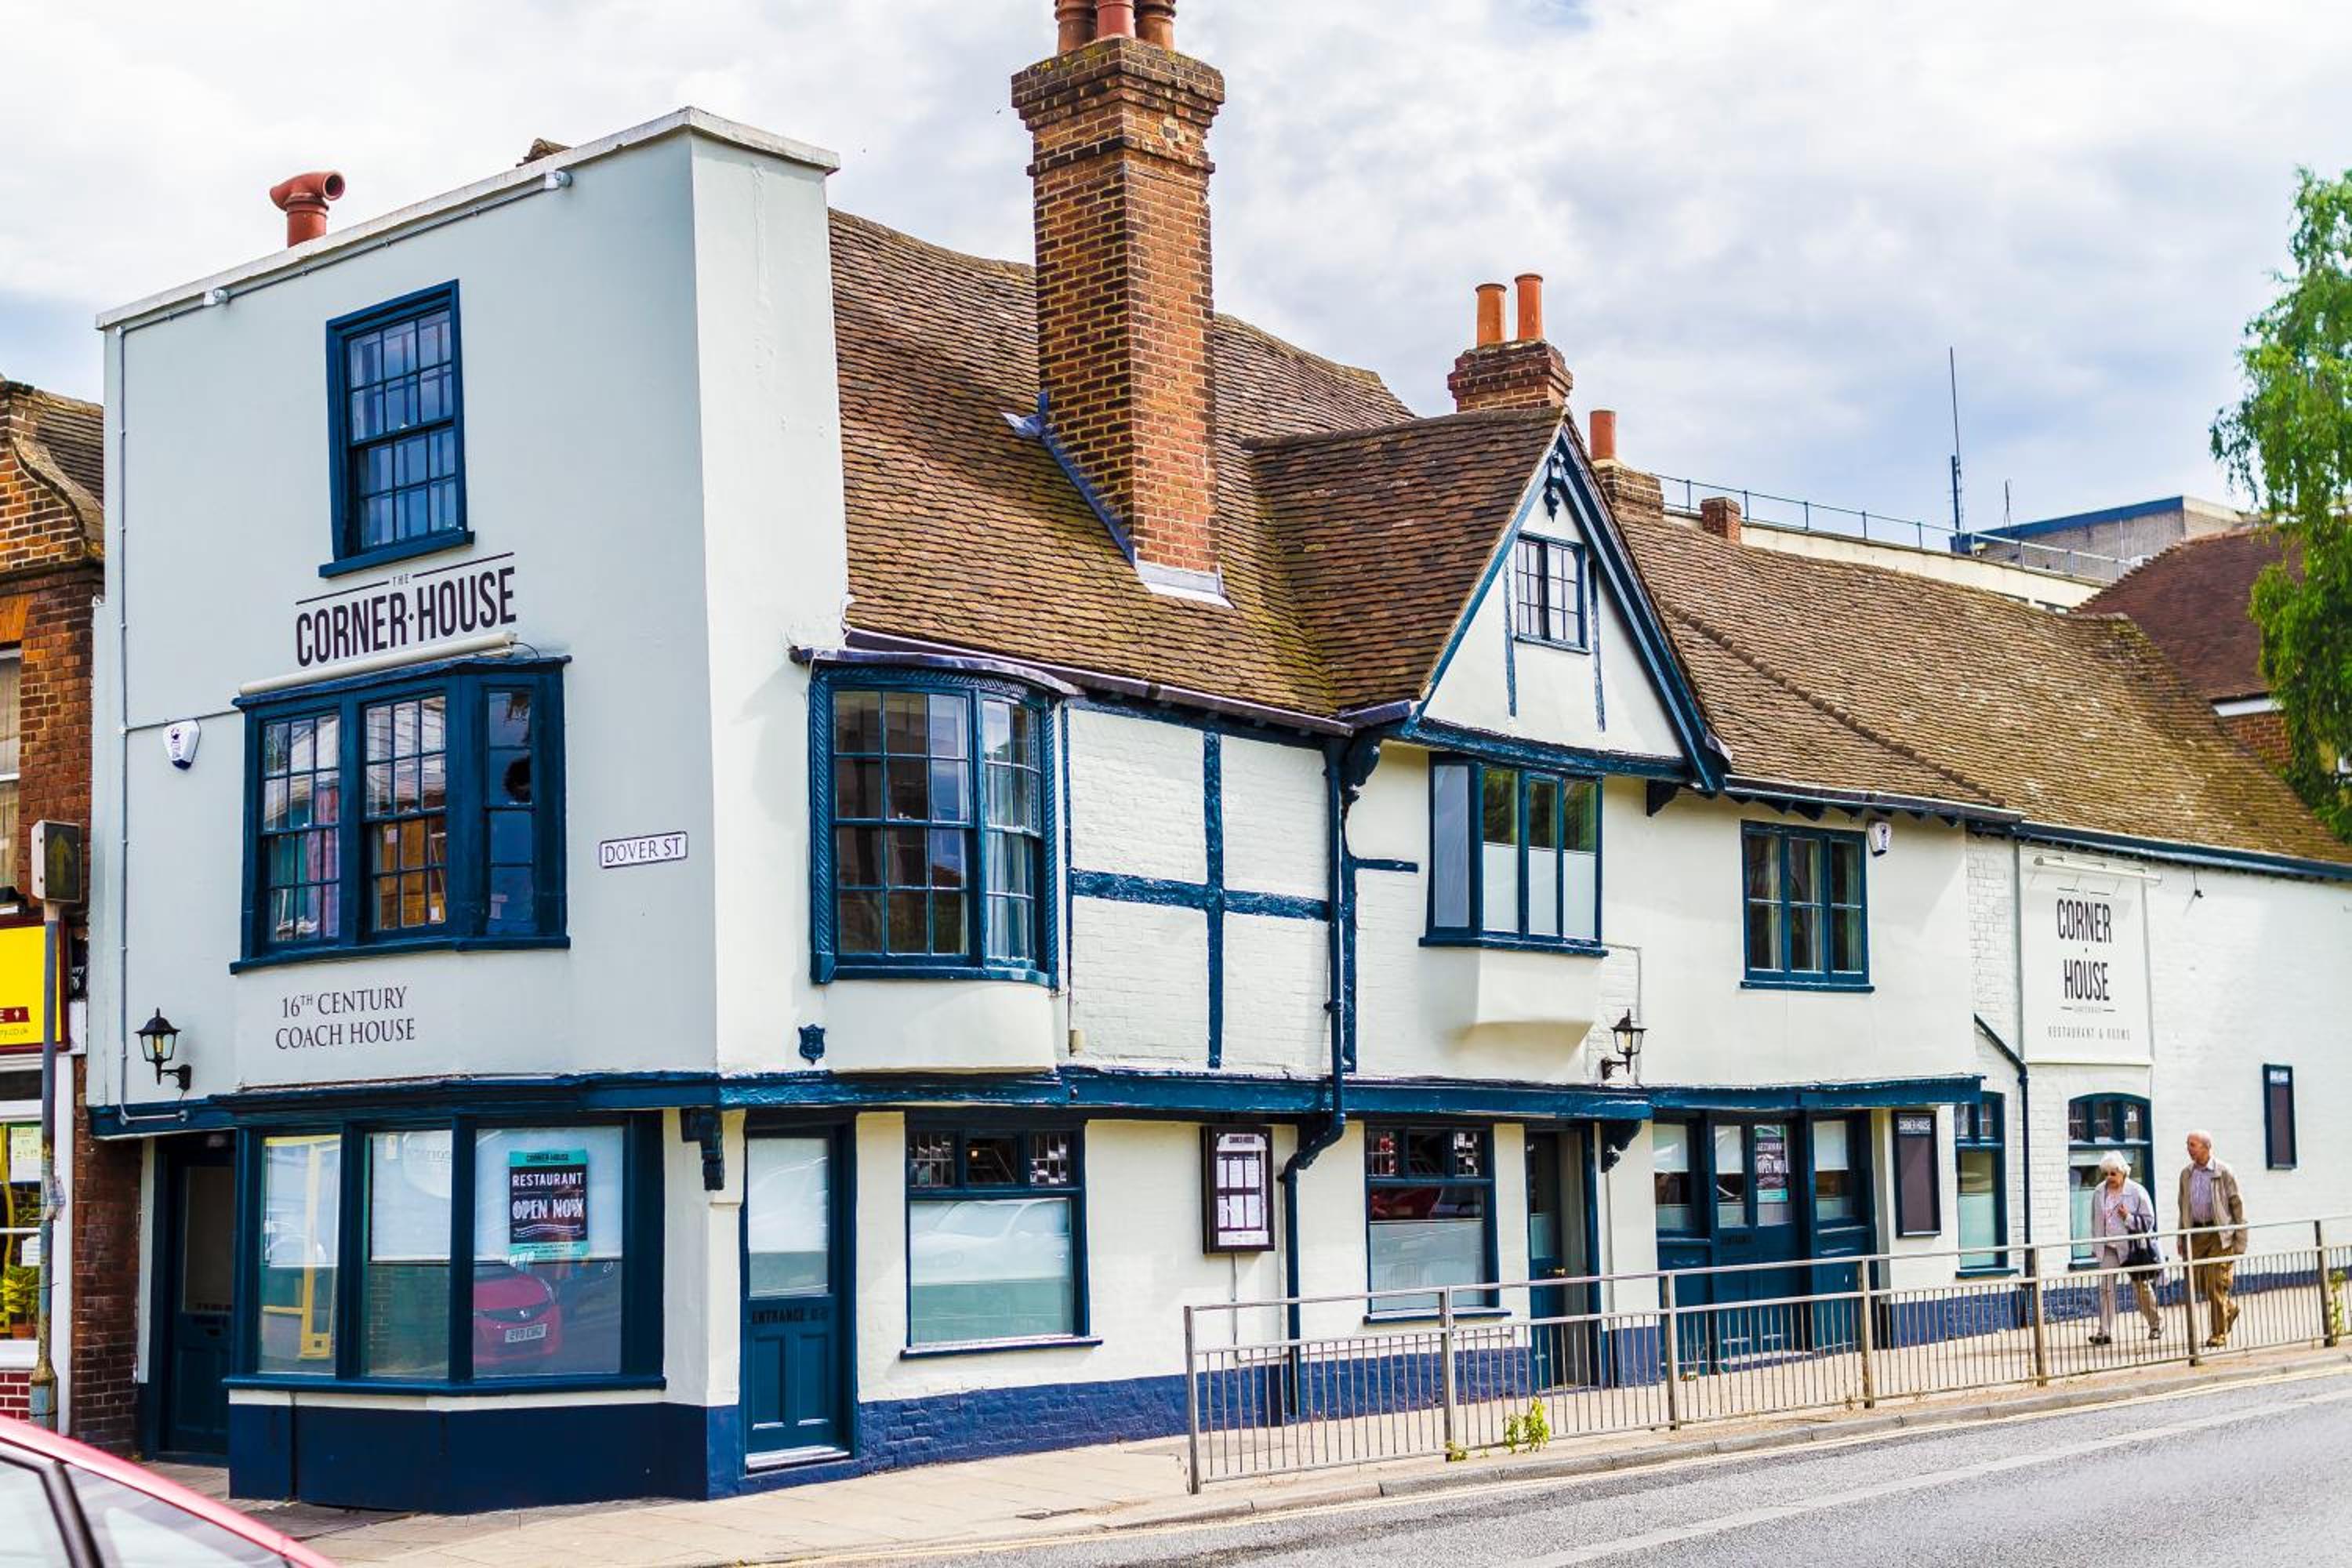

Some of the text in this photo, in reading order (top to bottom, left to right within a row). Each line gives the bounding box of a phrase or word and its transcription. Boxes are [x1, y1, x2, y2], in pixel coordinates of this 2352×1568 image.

[393, 573, 410, 586] THE
[296, 566, 517, 667] CORNER HOUSE
[604, 837, 681, 863] DOVER ST
[2056, 898, 2112, 943] CORNER
[2063, 959, 2110, 1001] HOUSE
[282, 985, 408, 1018] 16TH CENTURY
[275, 1018, 415, 1050] COACH HOUSE
[512, 1173, 583, 1187] RESTAURANT
[512, 1198, 584, 1219] OPEN NOW
